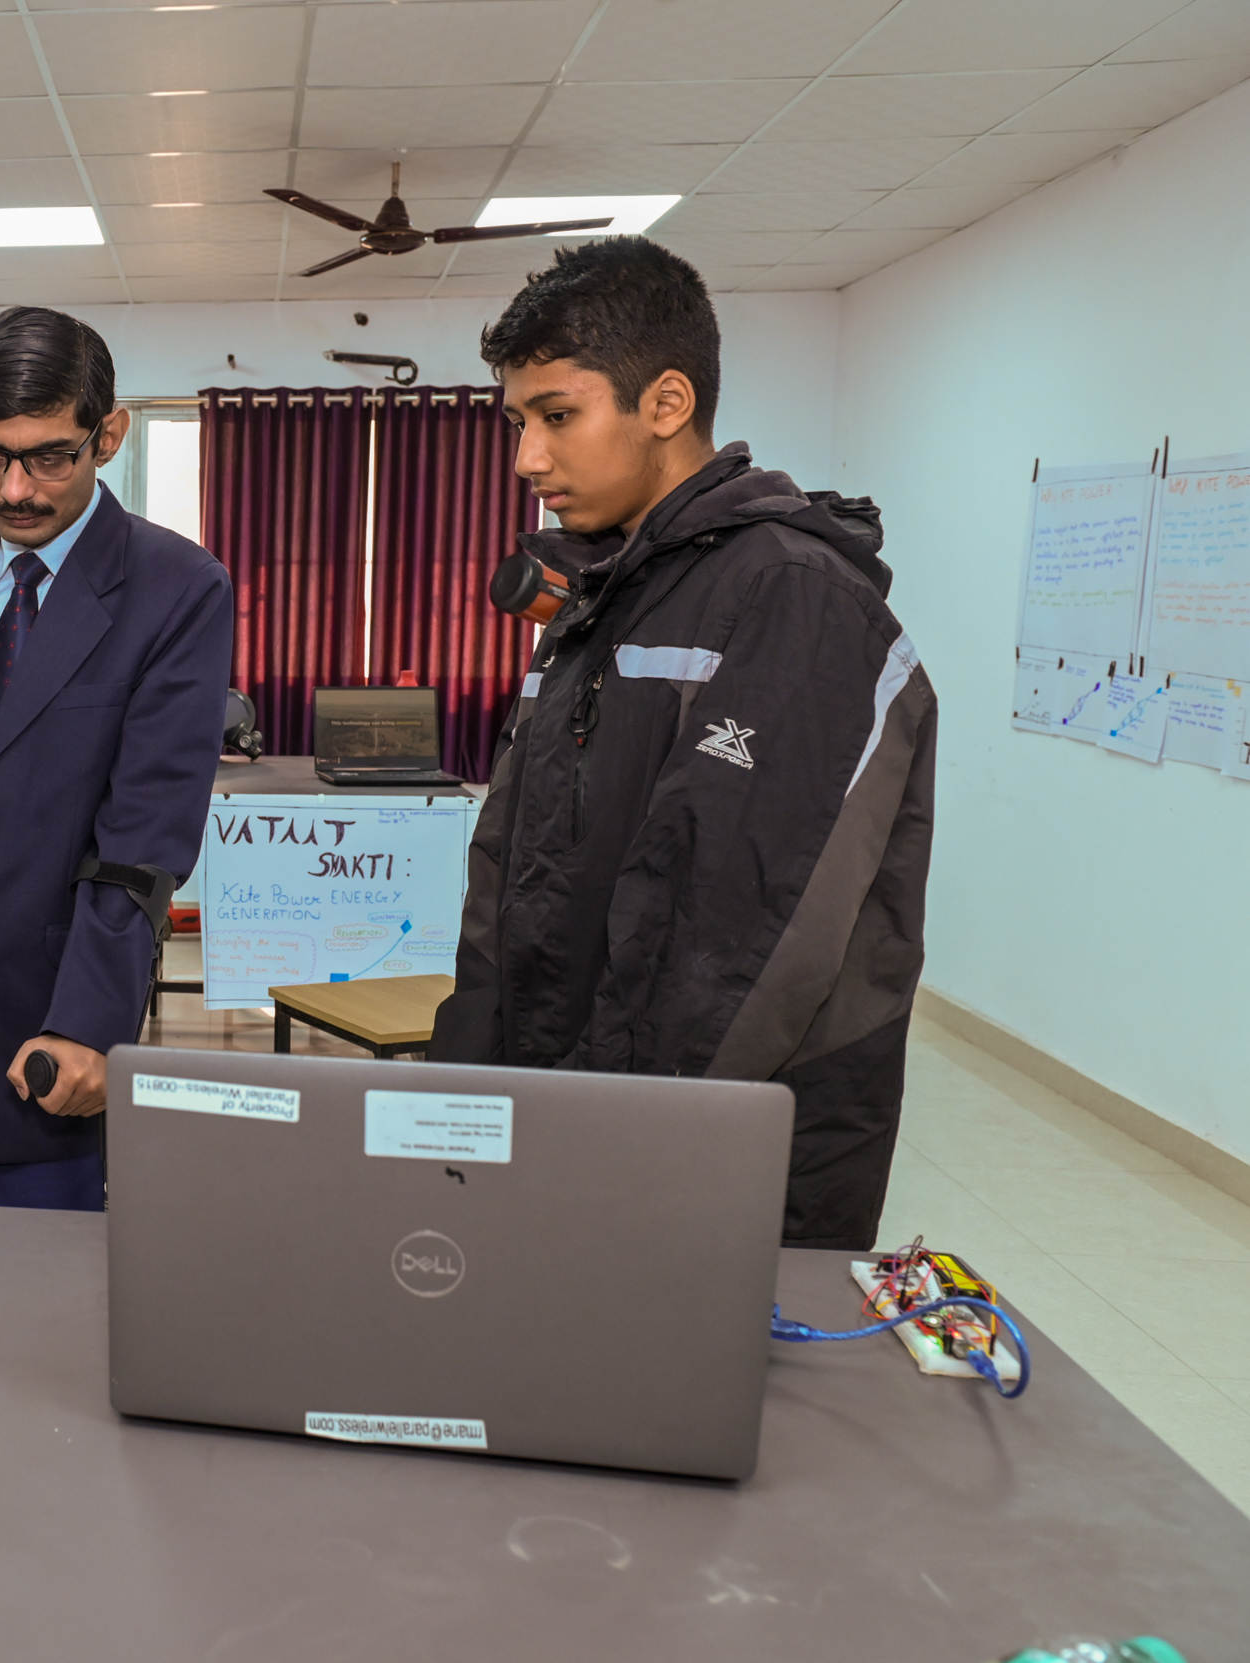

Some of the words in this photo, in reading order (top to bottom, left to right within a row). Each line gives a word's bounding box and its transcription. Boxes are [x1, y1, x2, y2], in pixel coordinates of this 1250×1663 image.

[219, 883, 261, 903] Kite
[271, 884, 322, 905] Power
[331, 889, 402, 905] ENERGY
[217, 906, 321, 920] GENERATION
[209, 936, 250, 951] Changing
[257, 938, 270, 946] the
[278, 940, 300, 951] way
[208, 965, 236, 977] energy
[245, 965, 268, 977] from
[222, 1100, 235, 1111] of
[246, 1087, 295, 1106] Parallel
[239, 1101, 295, 1119] Property
[401, 1252, 458, 1275] DELL
[309, 1416, 482, 1442] rmane@parallelwireless.com
